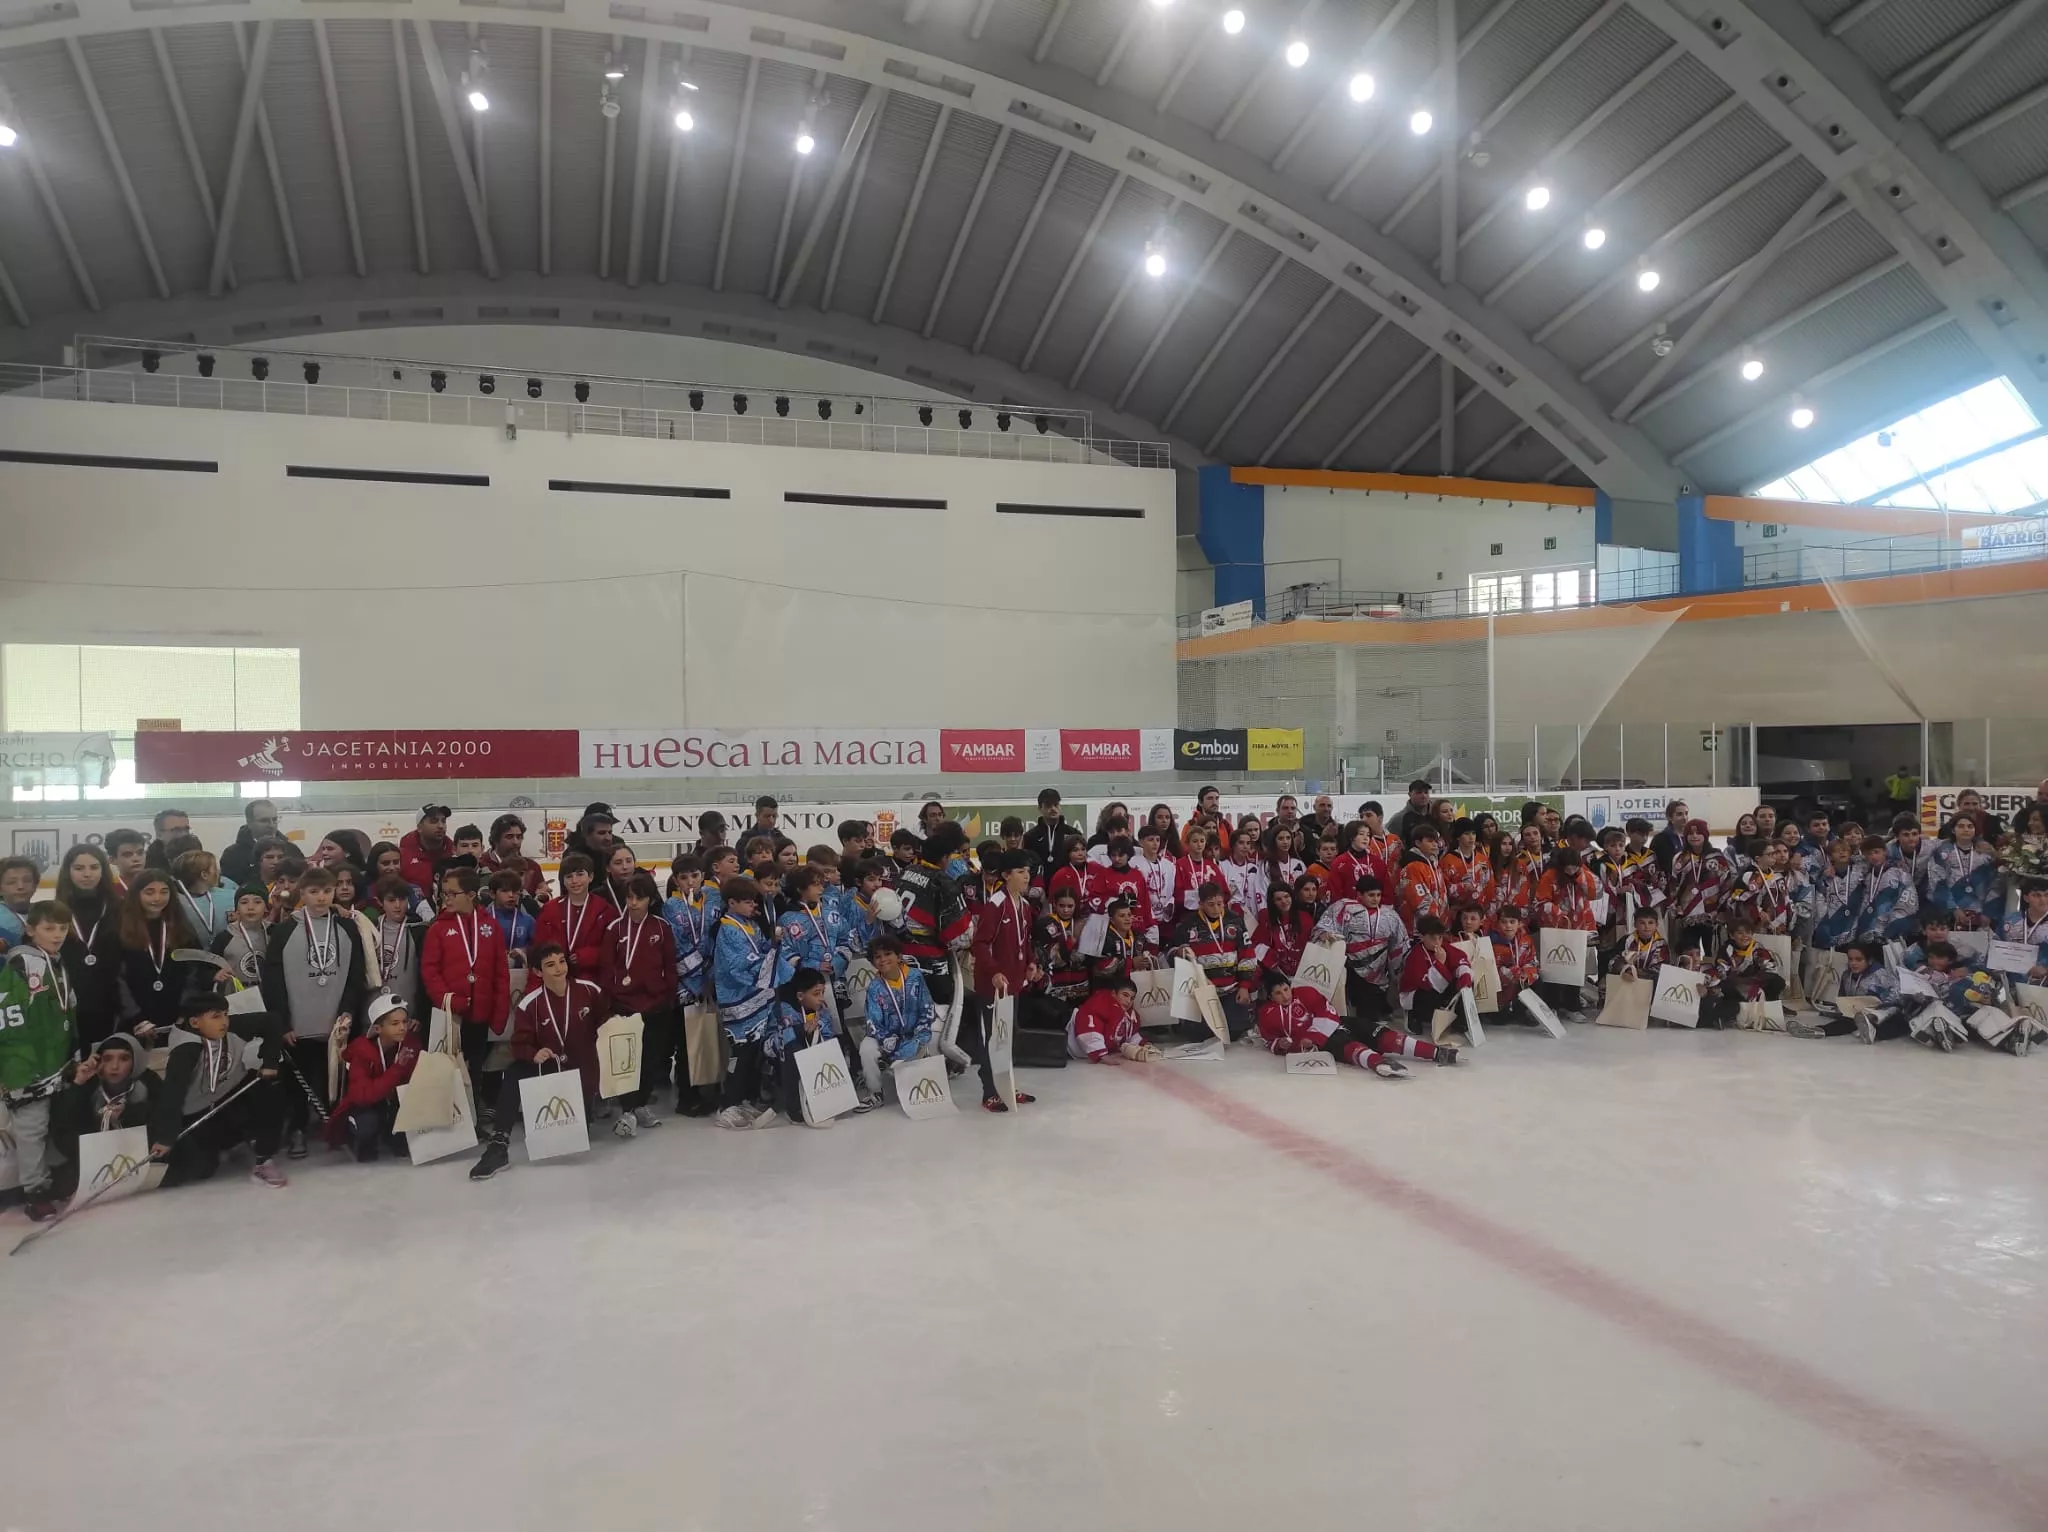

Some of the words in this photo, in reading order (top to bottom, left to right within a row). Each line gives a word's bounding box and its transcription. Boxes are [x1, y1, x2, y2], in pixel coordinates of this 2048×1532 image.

[302, 741, 492, 757] JACETANIA2000
[962, 743, 1015, 756] AMBAR
[1080, 743, 1131, 756] AMBAR
[1181, 739, 1239, 756] embou
